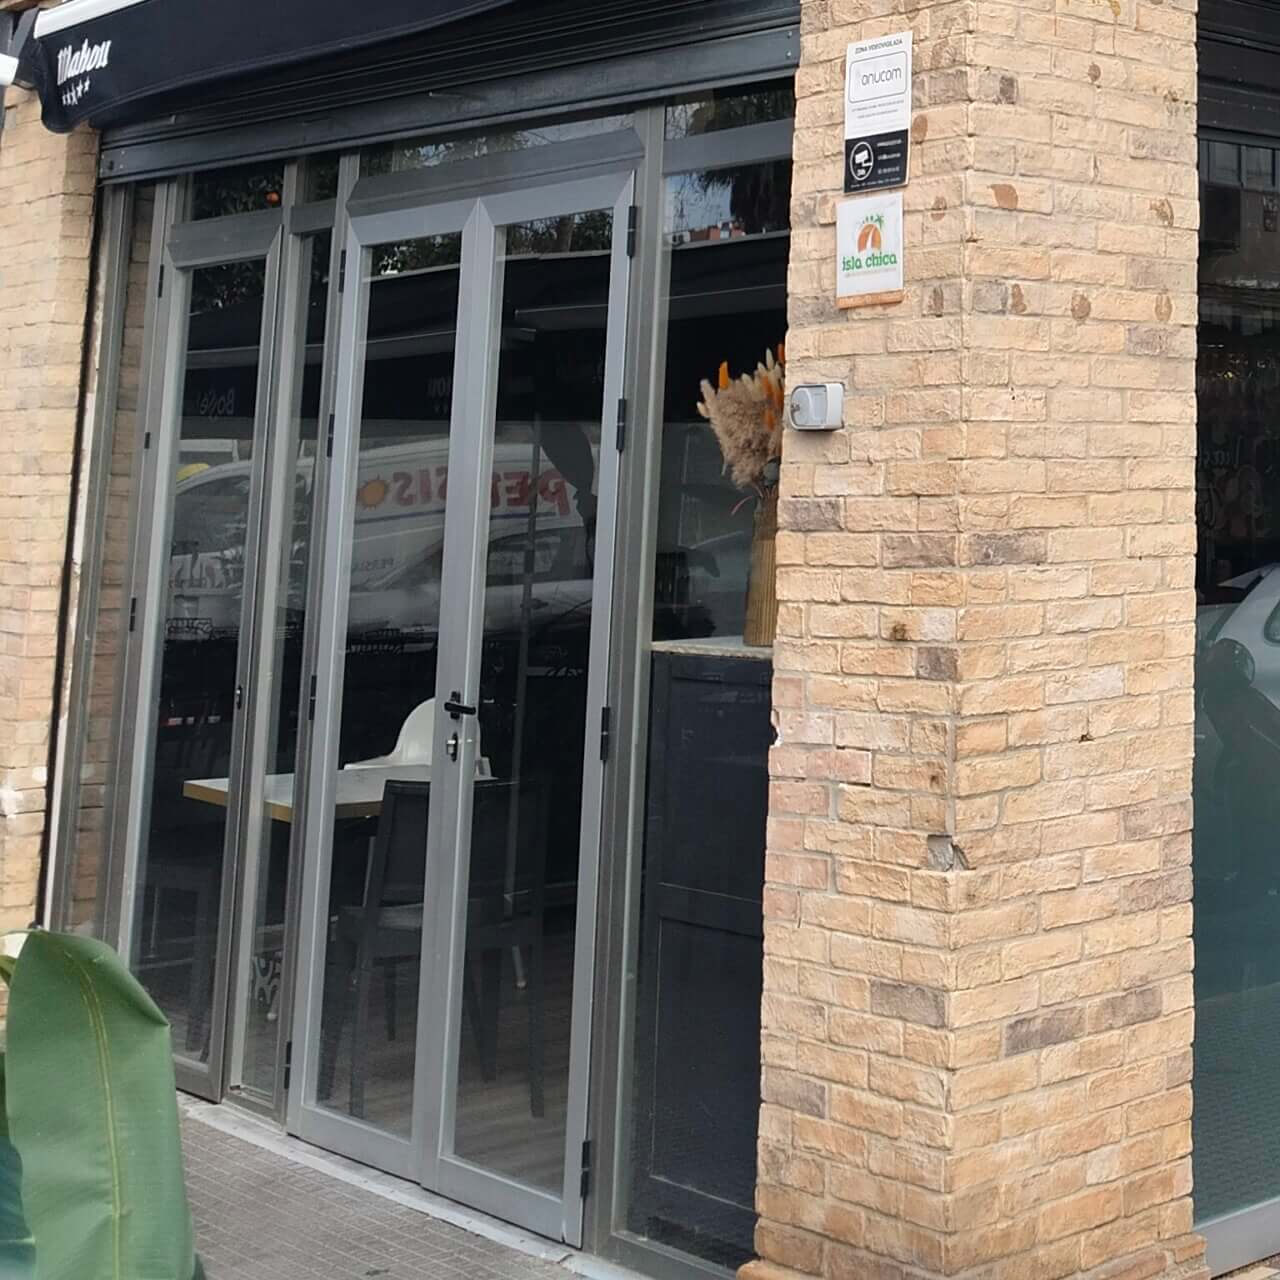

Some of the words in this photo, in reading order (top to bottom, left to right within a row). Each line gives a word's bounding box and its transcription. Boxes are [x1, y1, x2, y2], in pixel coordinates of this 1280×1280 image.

[57, 38, 112, 86] Mahou
[842, 255, 862, 272] isla
[865, 251, 898, 268] chica
